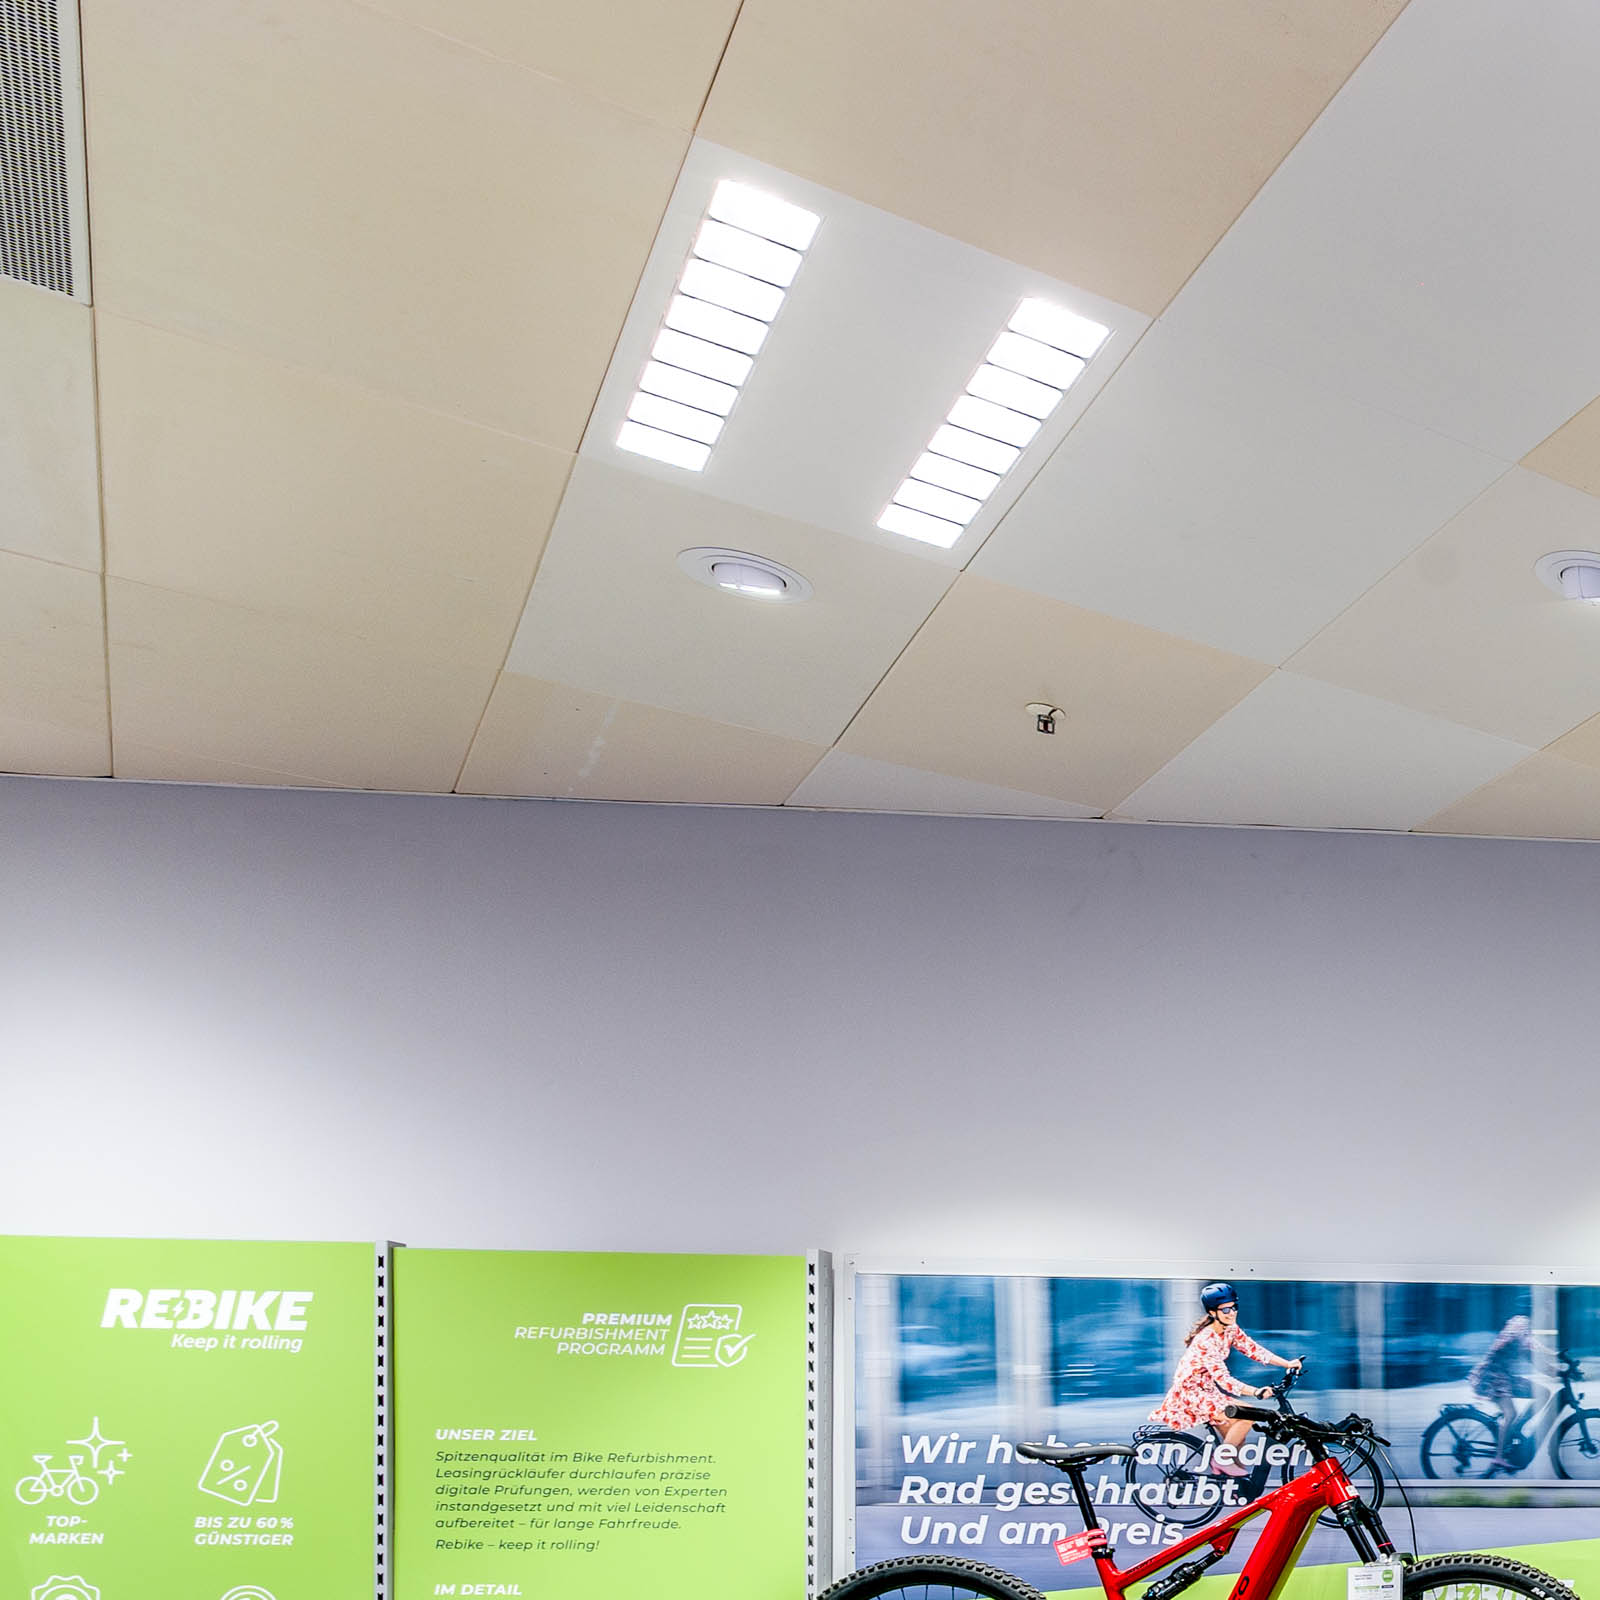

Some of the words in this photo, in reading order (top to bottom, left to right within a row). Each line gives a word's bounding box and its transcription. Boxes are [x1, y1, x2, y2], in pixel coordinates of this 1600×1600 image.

[100, 1288, 314, 1331] REBIKE
[582, 1313, 672, 1326] PREMIUM
[514, 1327, 670, 1340] REFURBISHMENT
[171, 1333, 218, 1352] Keep
[224, 1335, 237, 1349] it
[241, 1335, 303, 1353] rolling
[556, 1342, 665, 1356] PROGRAMM
[435, 1429, 495, 1441] UNSER
[499, 1429, 538, 1441] ZIEL
[902, 1433, 980, 1465] Wir
[1138, 1441, 1188, 1466] an
[435, 1451, 545, 1464] Spitzenqualität
[550, 1452, 568, 1463] im
[573, 1452, 603, 1463] Bike
[607, 1452, 716, 1464] Refurbishment.
[435, 1468, 566, 1481] Leasingrückläufer
[569, 1468, 657, 1480] durchlaufen
[660, 1469, 711, 1482] präzise
[435, 1484, 490, 1498] digitale
[494, 1484, 573, 1498] Prüfungen,
[578, 1486, 631, 1496] werden
[635, 1488, 660, 1496] von
[664, 1486, 727, 1499] Experten
[900, 1476, 987, 1504] Rad
[996, 1475, 1248, 1511] geschraubt.
[435, 1501, 542, 1514] instandgesetzt
[547, 1502, 574, 1513] und
[578, 1502, 603, 1513] mit
[606, 1502, 630, 1513] viel
[634, 1502, 726, 1514] Leidenschaft
[46, 1516, 88, 1528] TOP-
[194, 1517, 224, 1529] BIS
[228, 1517, 252, 1529] ZU
[256, 1517, 278, 1529] 60
[435, 1518, 515, 1529] aufbereitet
[530, 1518, 549, 1529] für
[554, 1519, 595, 1531] lange
[599, 1519, 681, 1530] Fahrfreude.
[902, 1516, 981, 1544] Und
[1000, 1521, 1068, 1545] am
[29, 1533, 104, 1545] MARKEN
[194, 1531, 294, 1546] GÜNSTIGER
[435, 1539, 484, 1550] Rebike
[499, 1539, 533, 1552] keep
[536, 1539, 546, 1550] it
[550, 1539, 600, 1552] rolling!
[434, 1584, 456, 1595] IM
[460, 1584, 522, 1596] DETAIL
